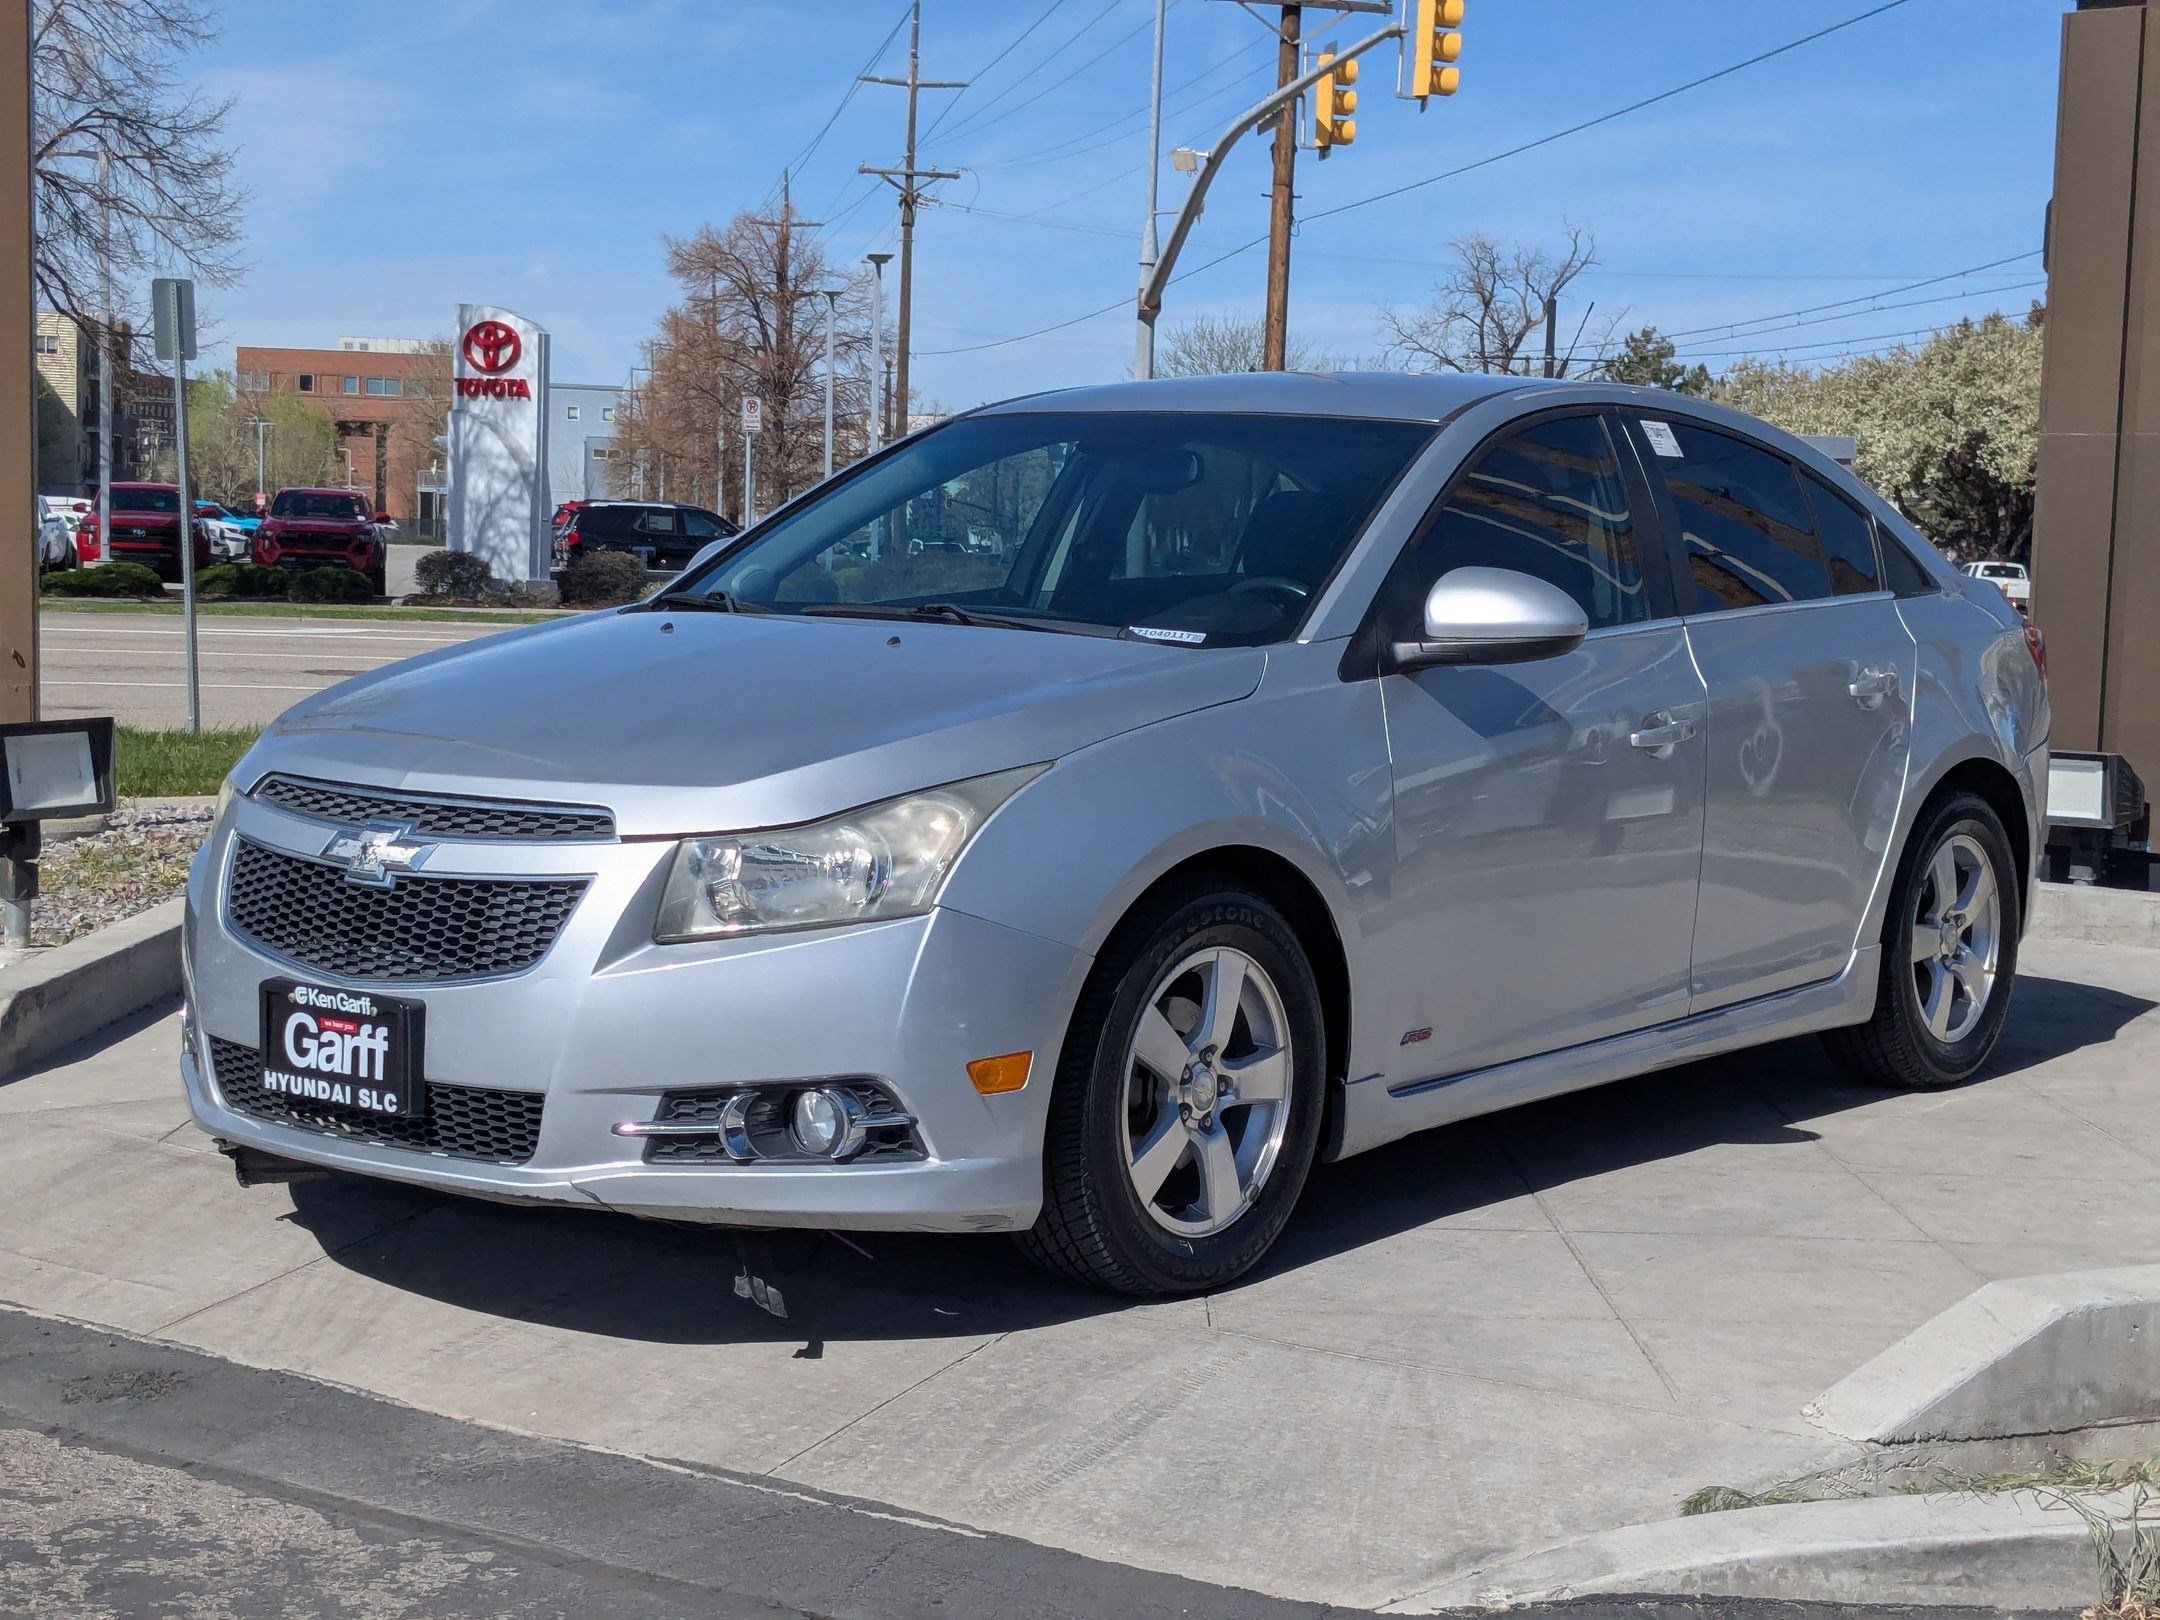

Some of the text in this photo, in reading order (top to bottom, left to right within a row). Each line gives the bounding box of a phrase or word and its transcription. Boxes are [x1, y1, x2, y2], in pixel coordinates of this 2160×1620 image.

[455, 378, 531, 400] TOYOTA
[285, 1012, 389, 1081] Garff
[264, 1070, 398, 1113] HYUNDAI SLC
